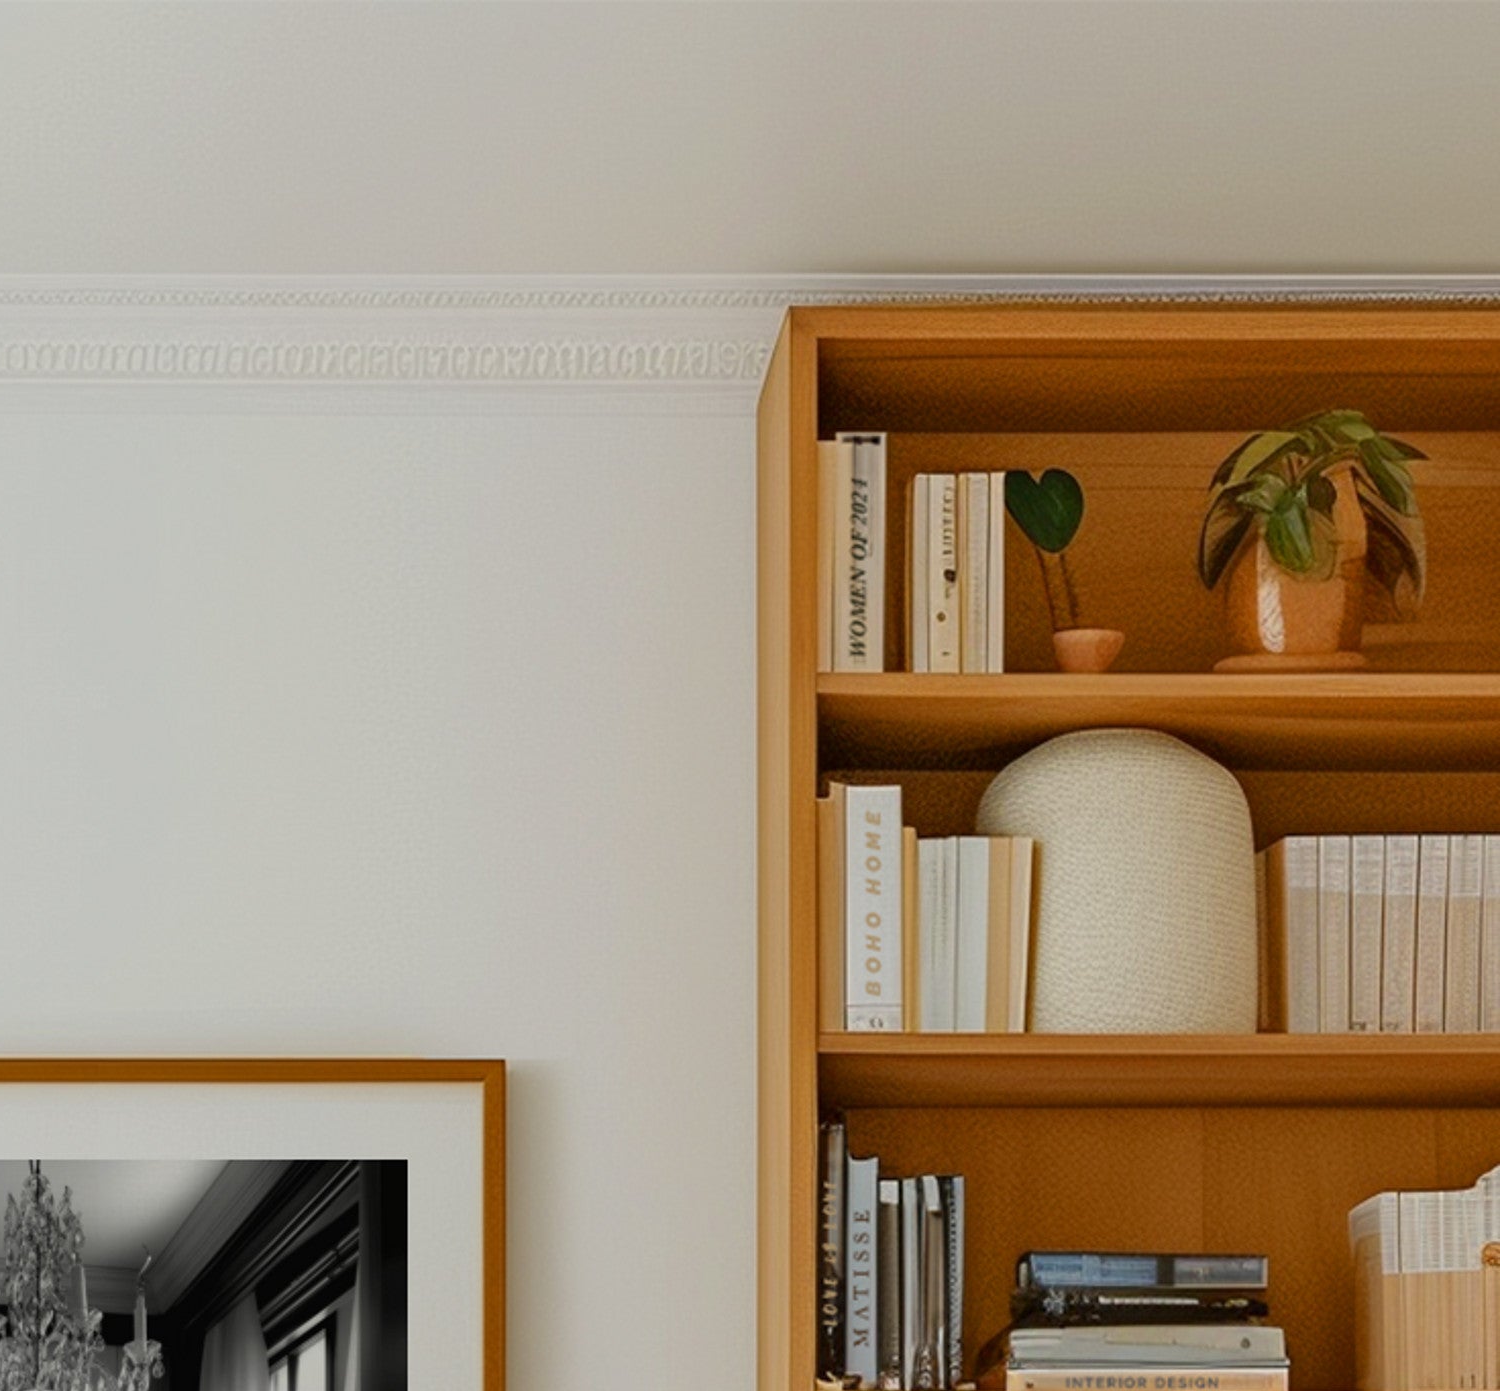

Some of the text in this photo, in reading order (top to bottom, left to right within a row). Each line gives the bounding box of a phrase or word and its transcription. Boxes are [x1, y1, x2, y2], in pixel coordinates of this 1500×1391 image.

[849, 477, 868, 658] WOMEN OF 2024
[865, 809, 882, 997] BOHO HOME
[852, 1209, 871, 1348] MATISSE
[1065, 1376, 1220, 1390] INTERIOR DESIGN
